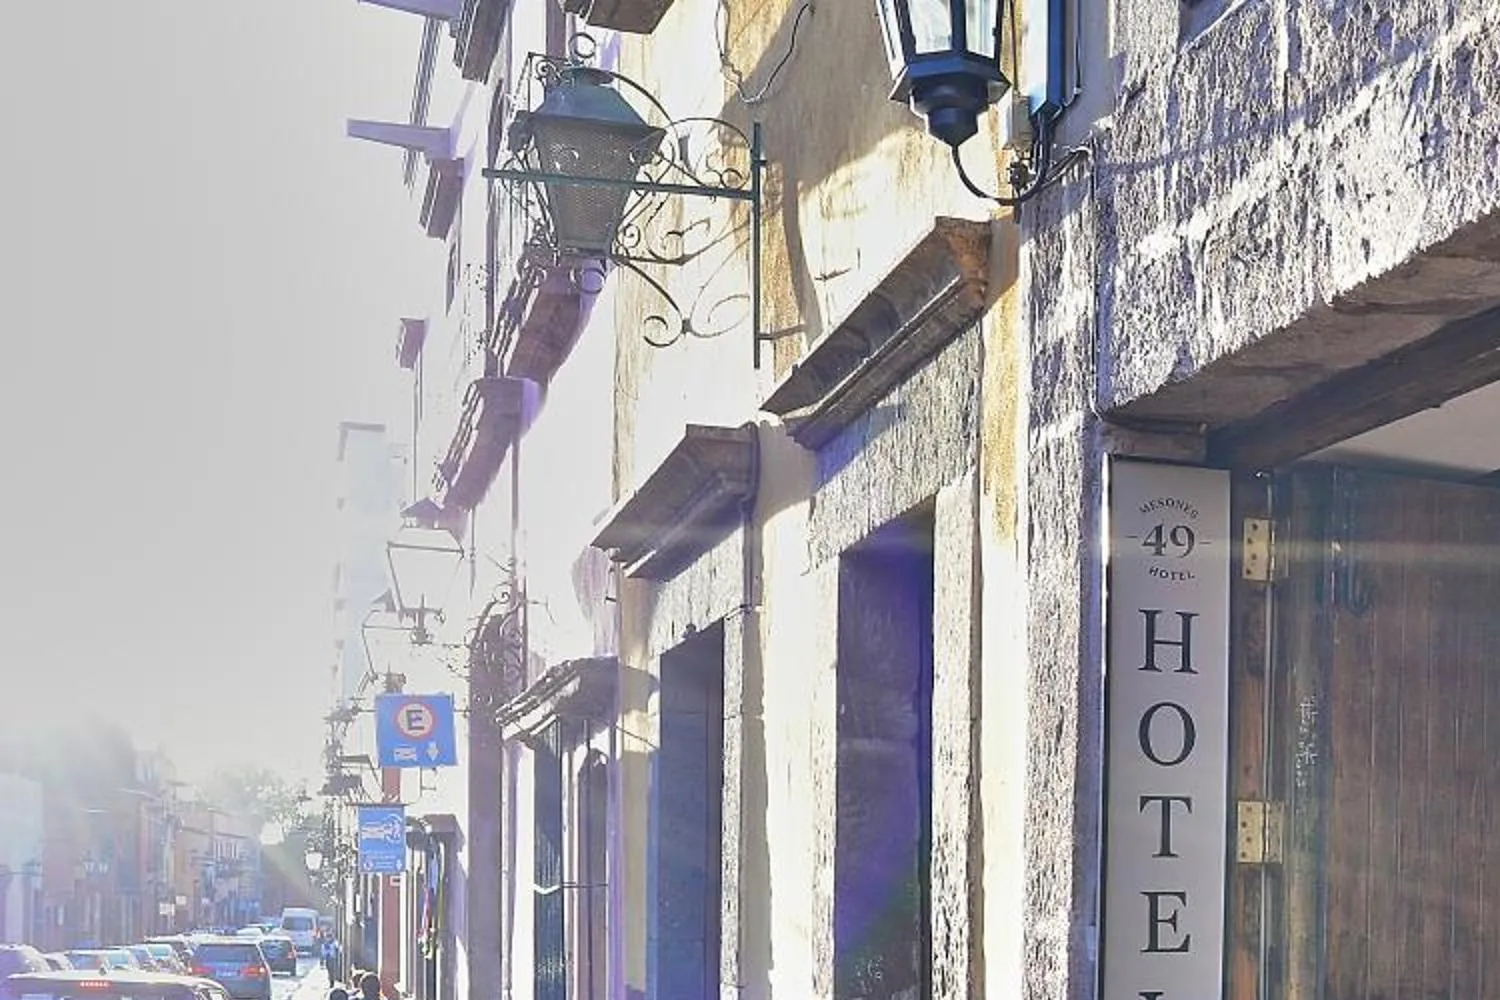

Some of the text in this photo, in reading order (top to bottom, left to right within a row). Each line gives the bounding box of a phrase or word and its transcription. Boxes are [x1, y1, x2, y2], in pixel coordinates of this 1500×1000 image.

[1139, 498, 1199, 519] MESONES
[1141, 523, 1195, 559] 49
[1149, 566, 1196, 581] HOTEL
[405, 709, 425, 731] E
